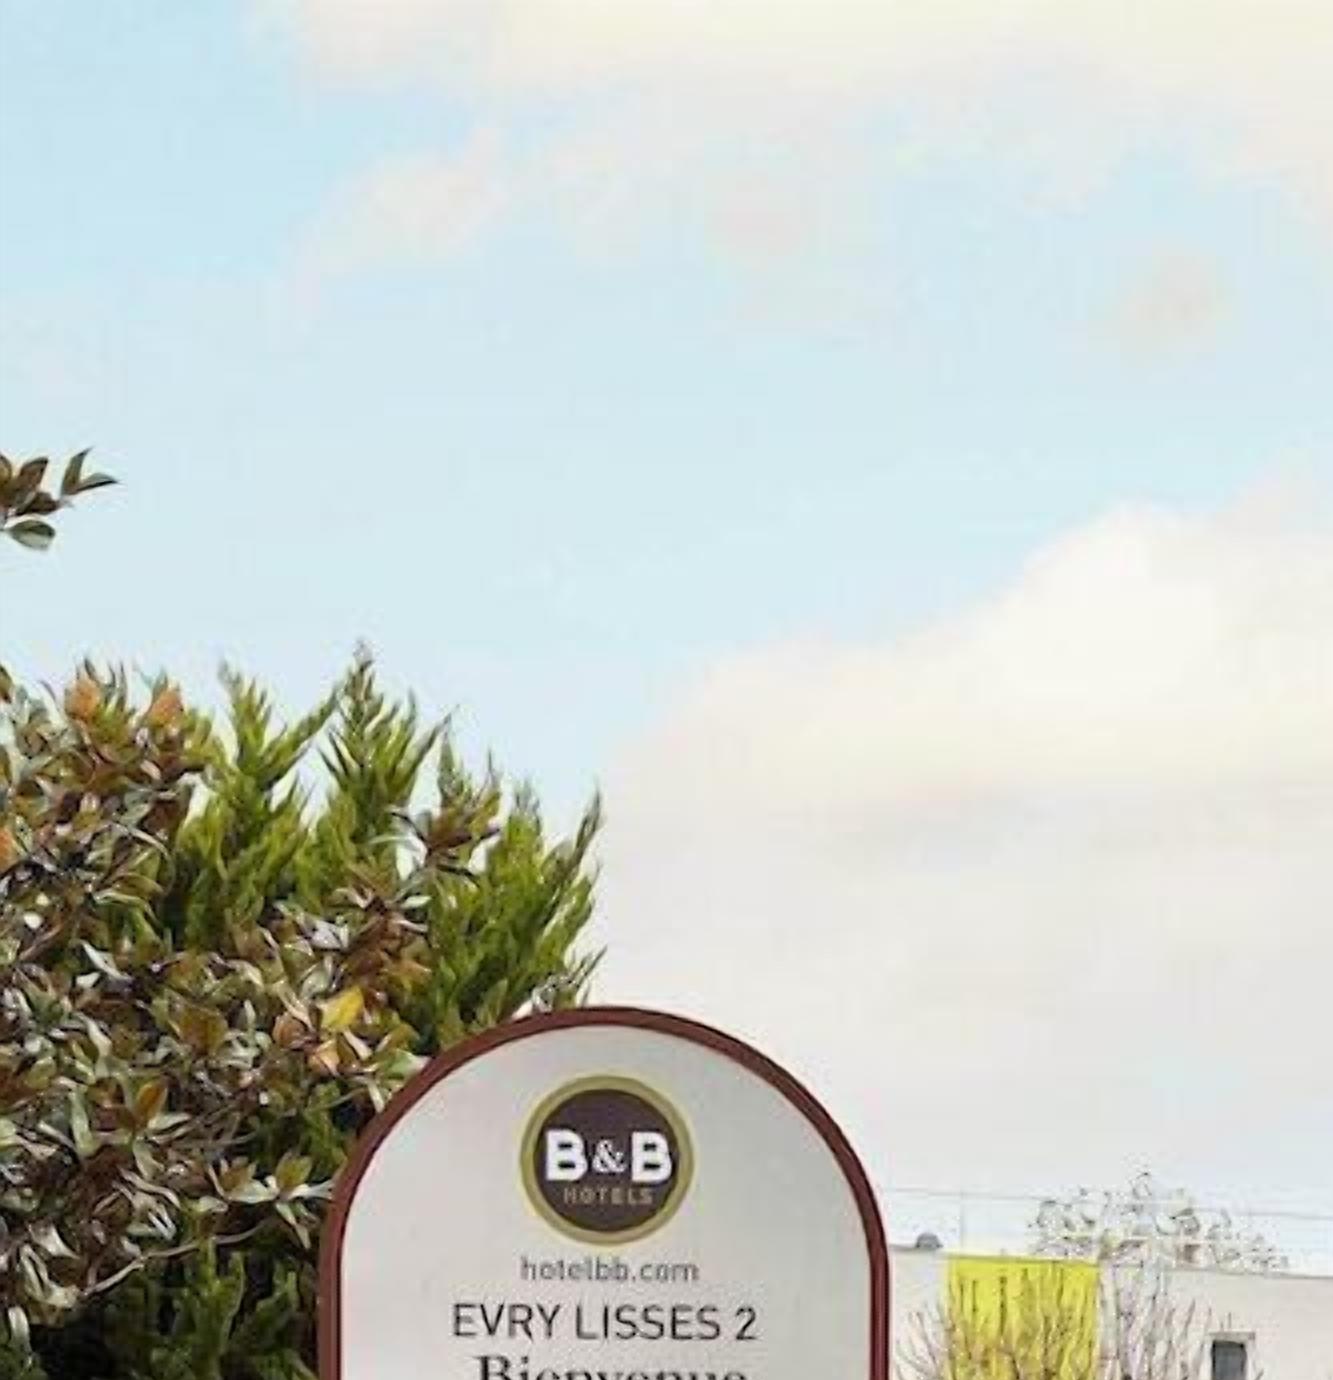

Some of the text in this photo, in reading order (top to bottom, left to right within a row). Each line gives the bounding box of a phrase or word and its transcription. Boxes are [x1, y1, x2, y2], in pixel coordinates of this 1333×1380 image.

[546, 1127, 673, 1183] B&B
[564, 1187, 653, 1204] HOTELS
[520, 1257, 699, 1283] hotelbb.com
[453, 1303, 757, 1340] EVRY LISSES 2
